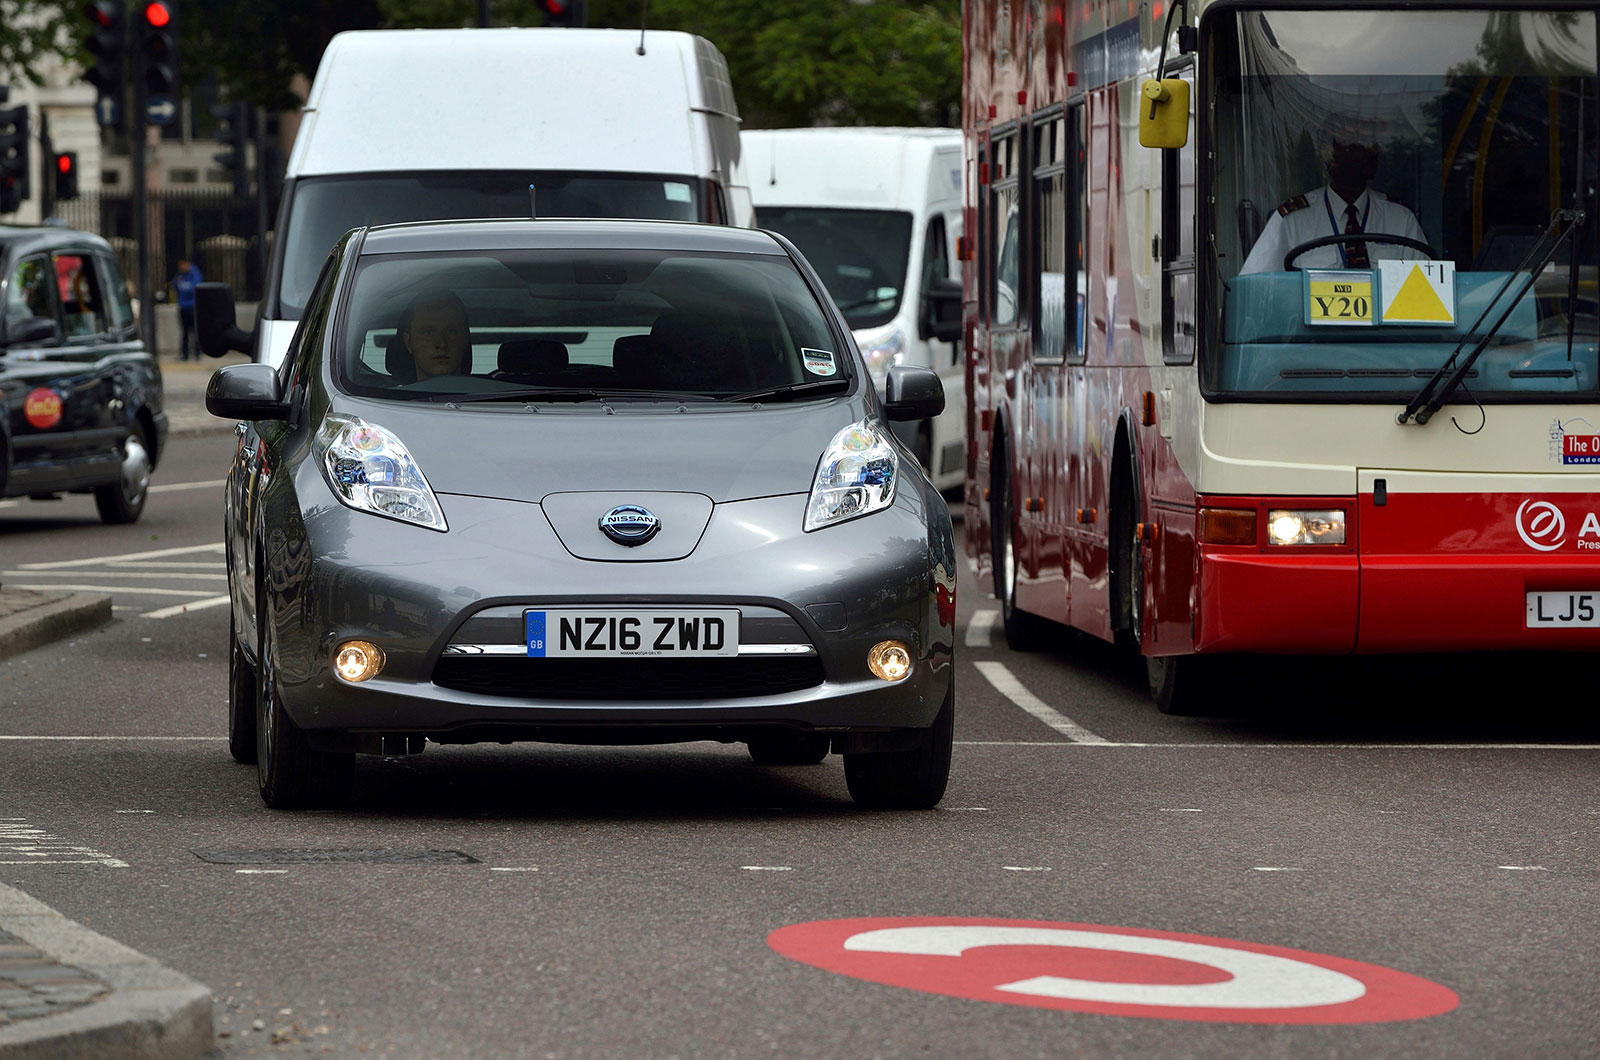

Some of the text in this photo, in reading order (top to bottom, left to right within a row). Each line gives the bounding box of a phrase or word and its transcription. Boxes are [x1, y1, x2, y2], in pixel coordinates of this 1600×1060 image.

[1315, 296, 1368, 317] Y20
[1568, 435, 1588, 452] The
[607, 515, 653, 523] NISSAN
[1537, 595, 1594, 622] LJ5
[560, 617, 725, 651] NZ16 ZWD
[530, 639, 543, 649] GB
